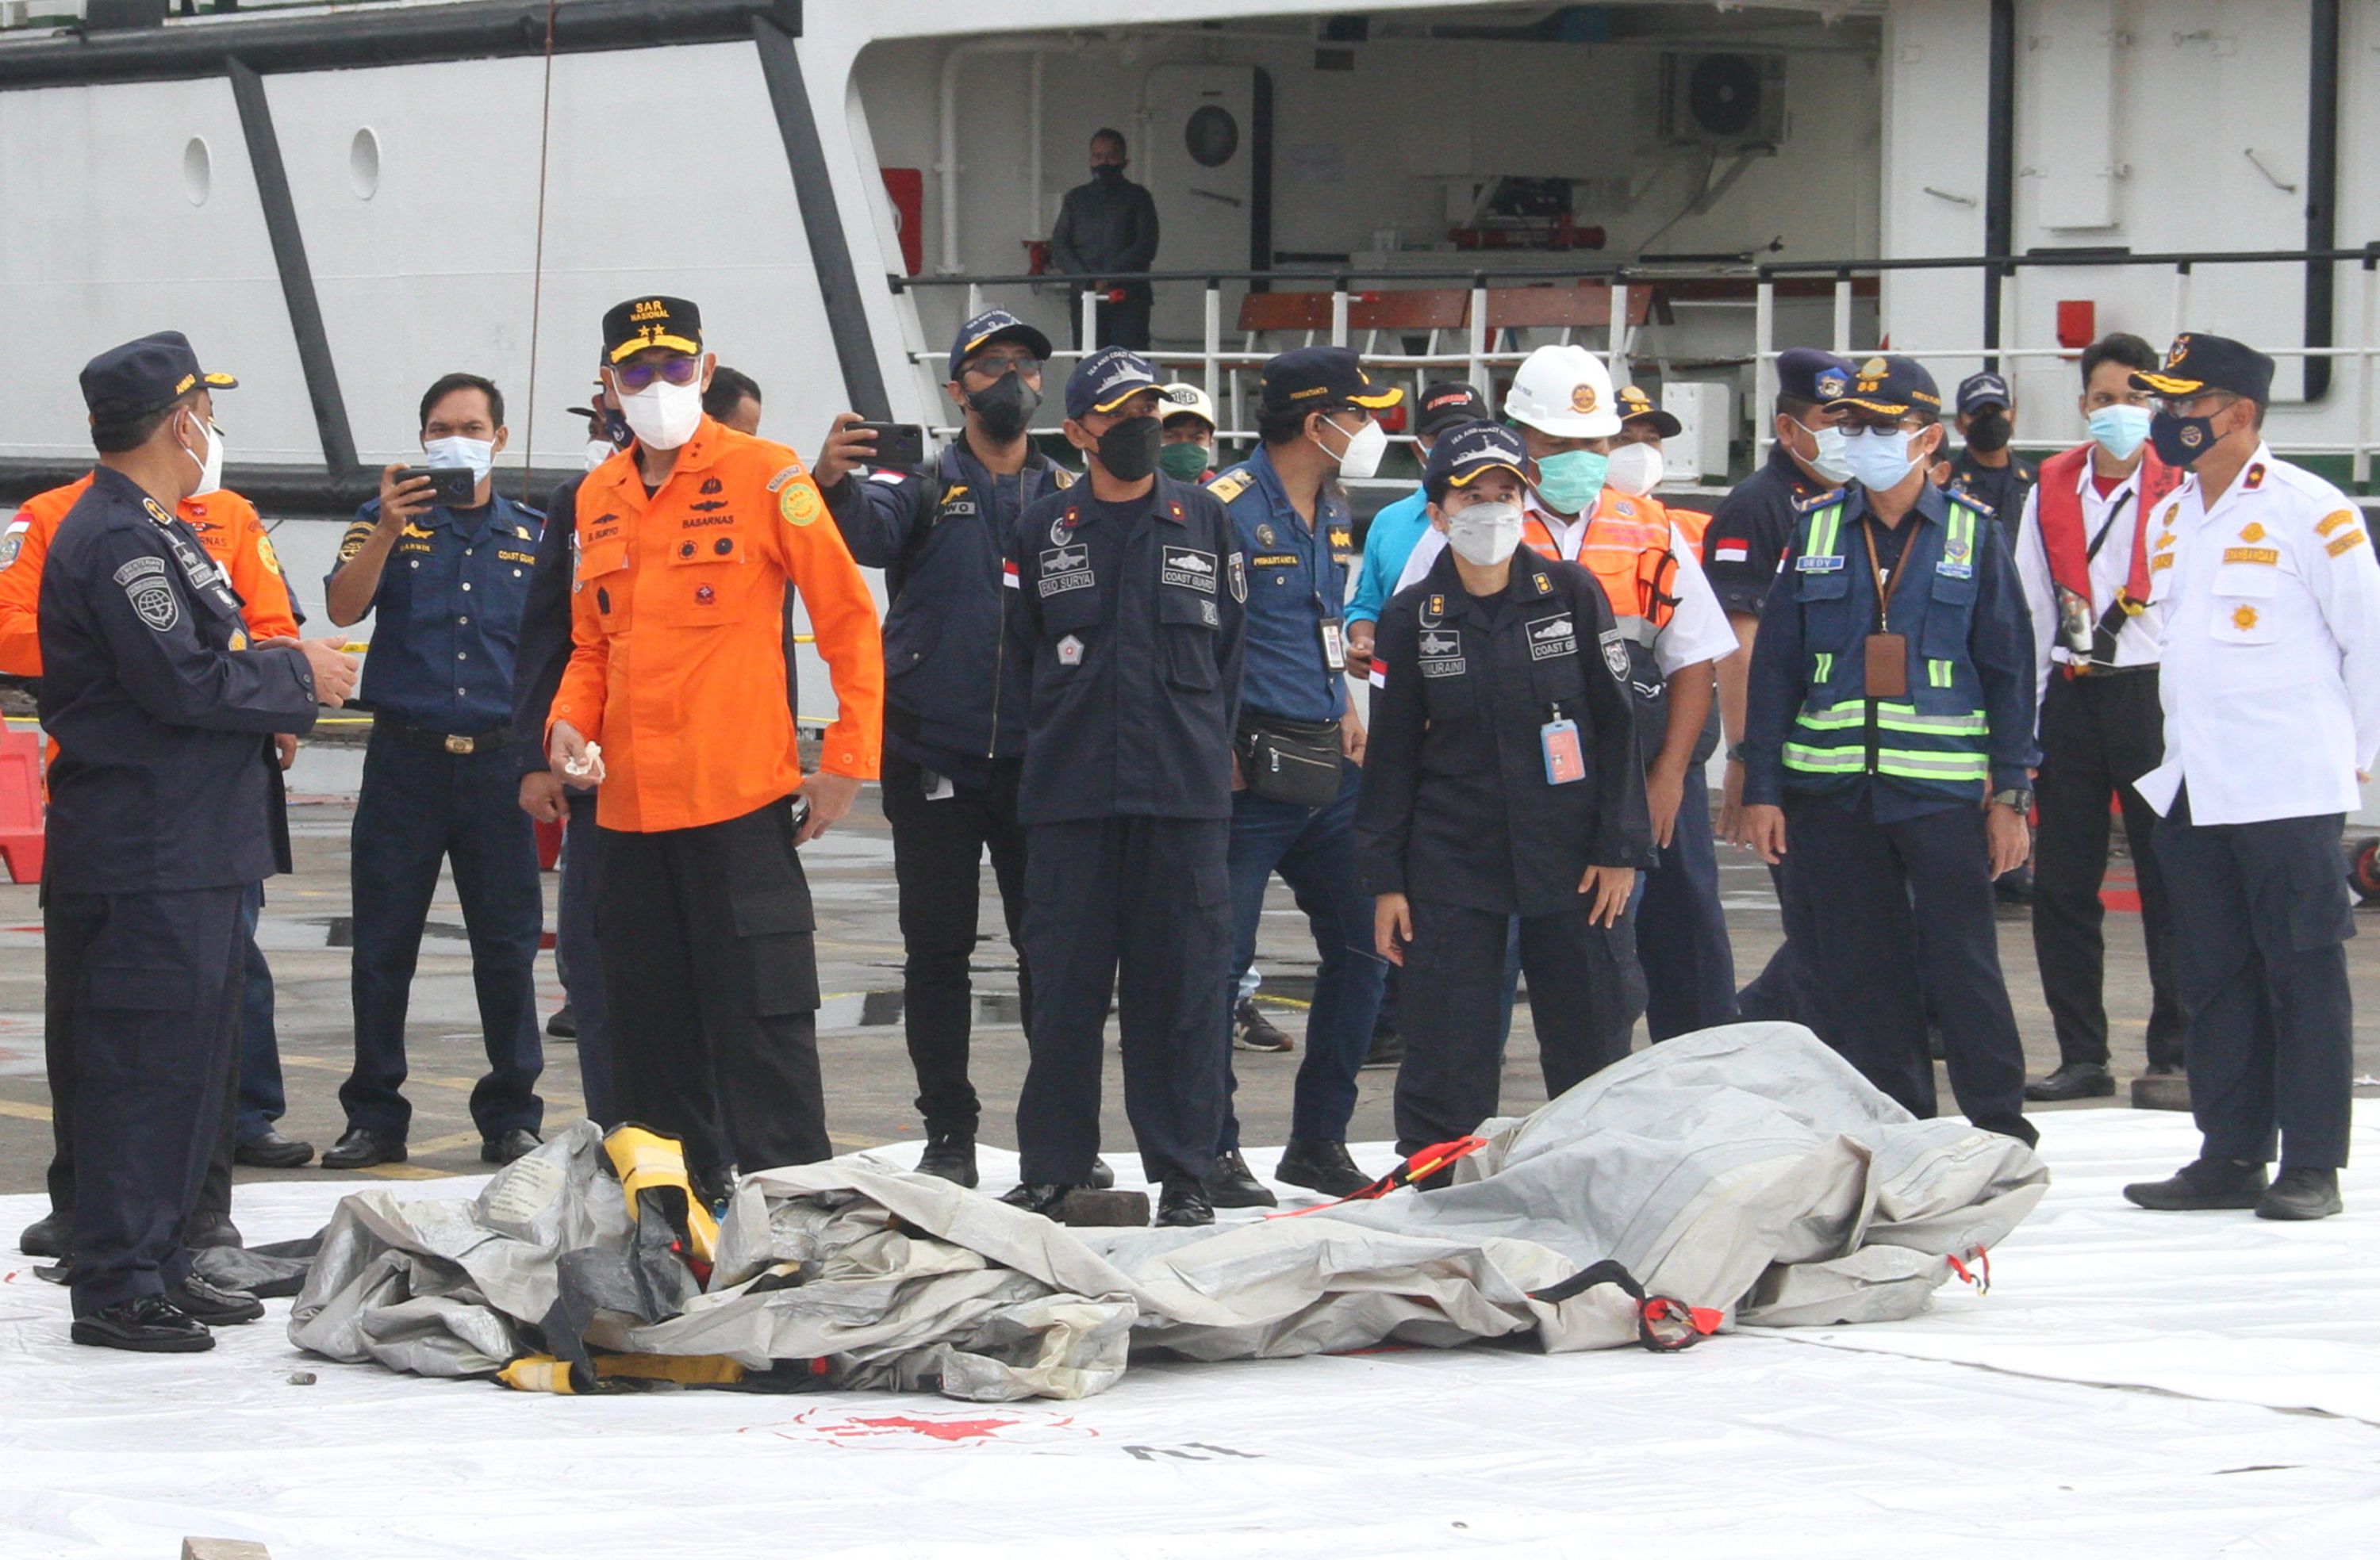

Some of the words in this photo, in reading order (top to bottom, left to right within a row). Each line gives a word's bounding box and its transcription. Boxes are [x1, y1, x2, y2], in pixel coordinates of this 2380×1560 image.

[635, 301, 662, 312] SAR
[630, 310, 670, 321] NASIONAL
[1087, 366, 1098, 377] SEA
[1097, 355, 1110, 368] AND
[1450, 434, 1463, 445] SEA
[682, 516, 734, 529] BASARNAS
[498, 550, 520, 560] COAST
[1803, 558, 1831, 567] DEDY
[1042, 581, 1058, 594] EKO
[1060, 573, 1091, 588] SURYA
[1165, 572, 1192, 584] COAST
[1192, 577, 1214, 590] GUARD
[1535, 642, 1564, 657] COAST
